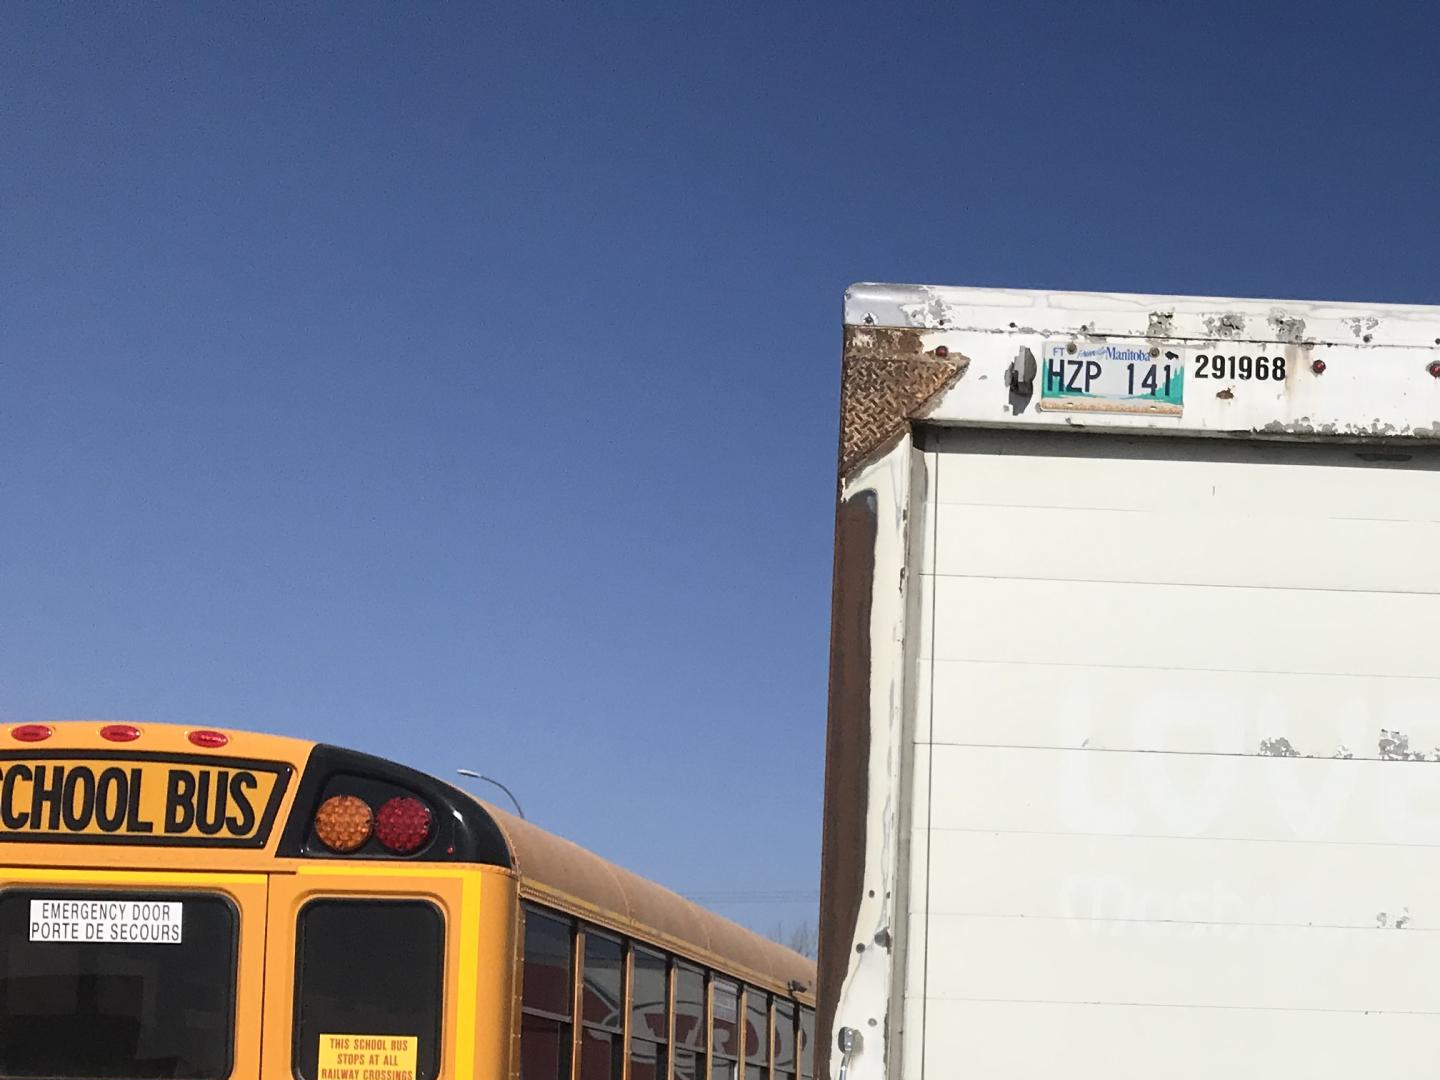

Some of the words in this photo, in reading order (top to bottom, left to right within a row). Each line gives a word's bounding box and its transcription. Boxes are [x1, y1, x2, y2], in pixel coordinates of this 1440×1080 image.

[1106, 346, 1151, 361] Manitoba
[1194, 354, 1287, 381] 291968
[1047, 358, 1102, 393] HZP
[1127, 362, 1172, 397] 141
[0, 764, 153, 833] CHOOL
[164, 770, 258, 837] BUS
[42, 902, 126, 921] EMERGENCY
[133, 904, 170, 921] DOOR
[31, 922, 79, 940] PORTE
[86, 923, 104, 940] DE
[110, 924, 180, 942] SECOURS
[330, 1038, 350, 1050] THIS
[353, 1039, 387, 1051] SCHOOL
[391, 1040, 408, 1052] BUS
[337, 1053, 365, 1065] STOPS
[369, 1054, 380, 1065] AT
[383, 1054, 398, 1066] ALL
[321, 1068, 360, 1080] RAILWAY
